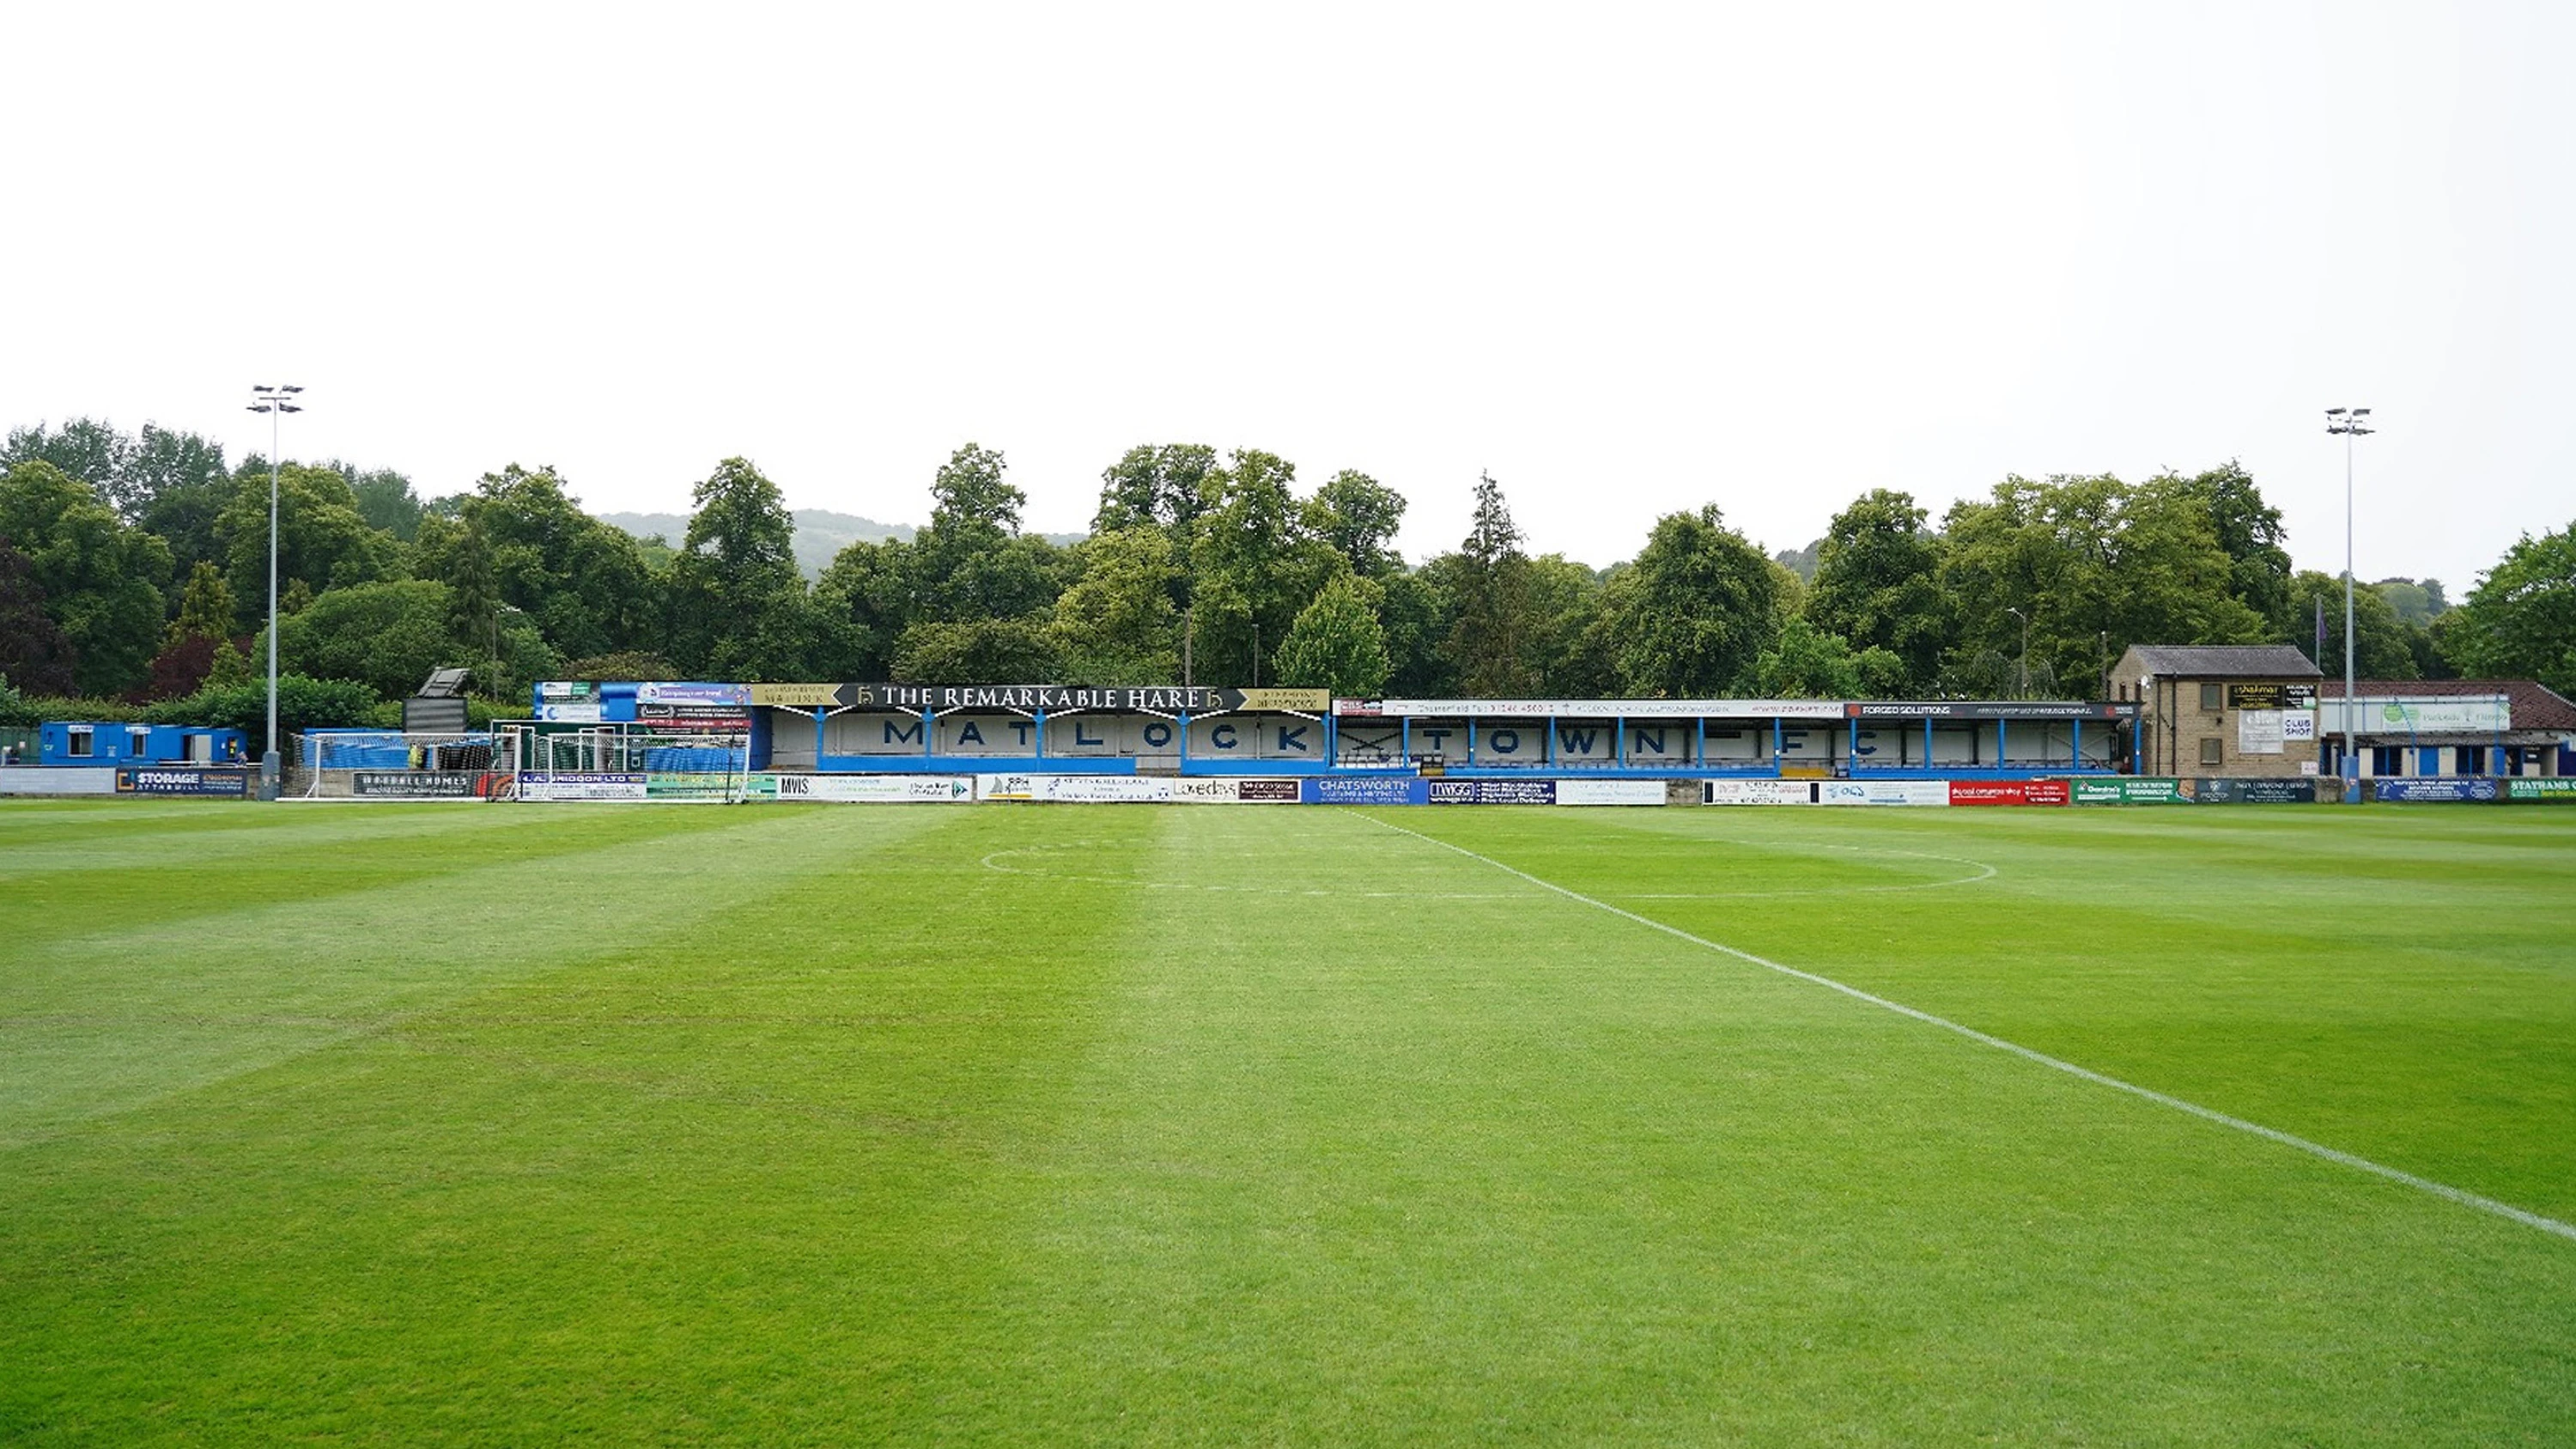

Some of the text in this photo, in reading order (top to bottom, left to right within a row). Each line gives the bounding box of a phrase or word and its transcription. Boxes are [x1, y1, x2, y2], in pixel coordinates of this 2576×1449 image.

[883, 687, 1198, 708] THE REMARKABLE HARE
[137, 773, 200, 784] STORAGE
[1319, 781, 1410, 790] CHATSWORTH
[781, 777, 810, 795] MVIS
